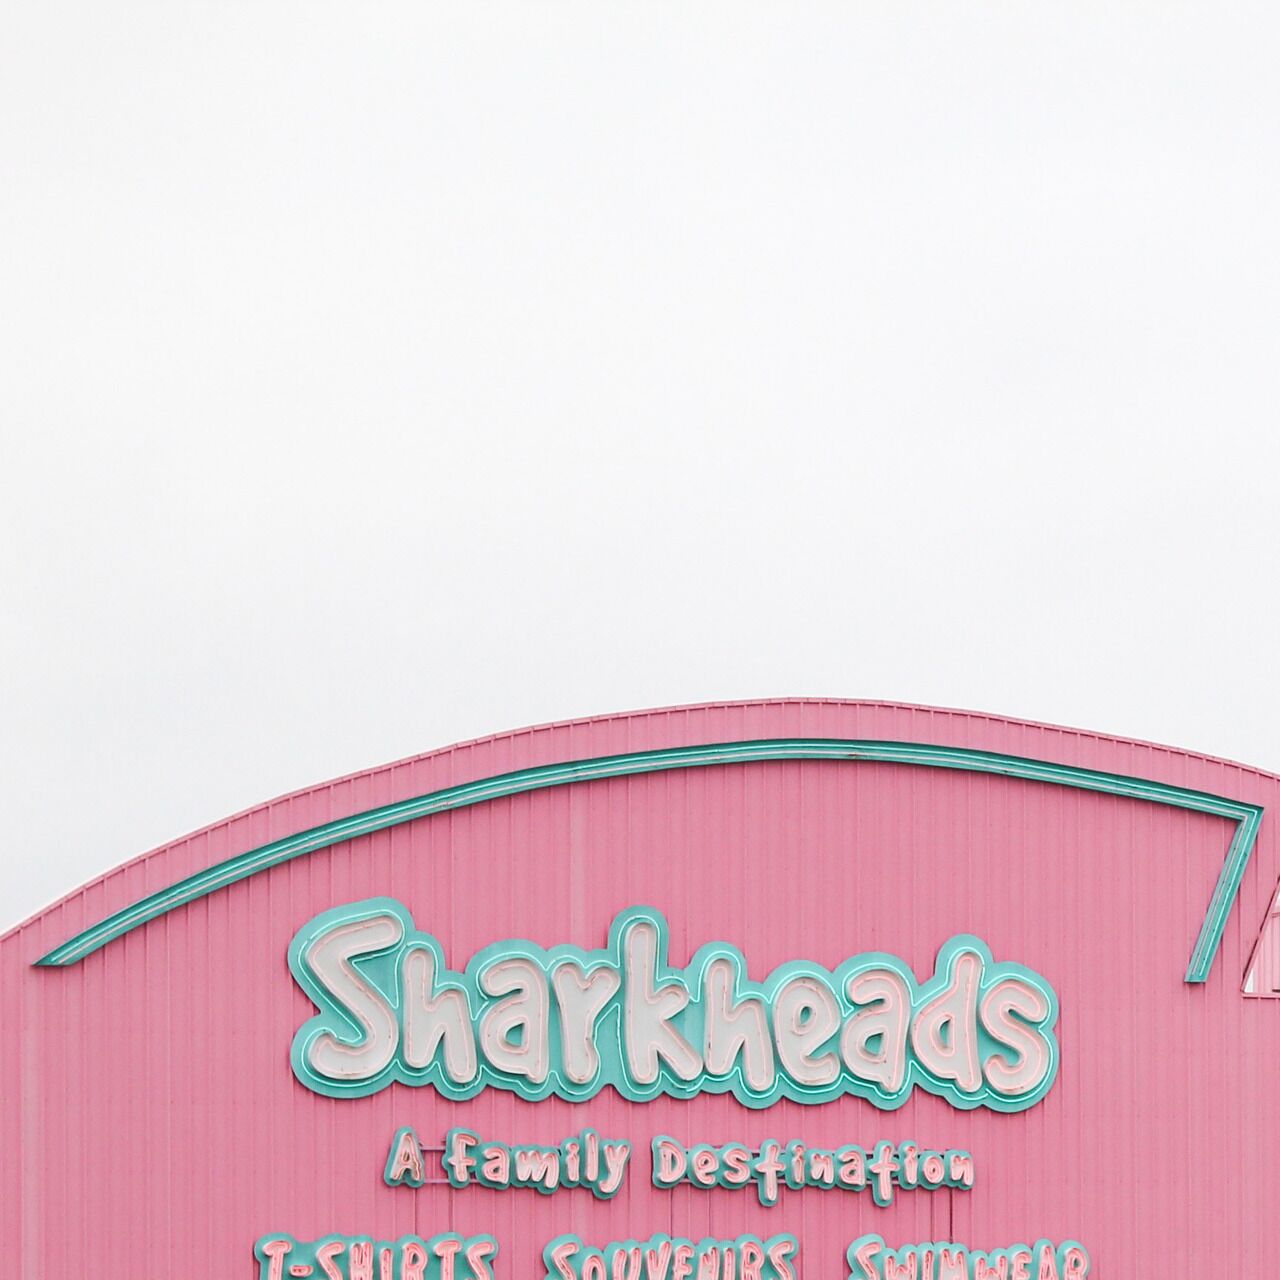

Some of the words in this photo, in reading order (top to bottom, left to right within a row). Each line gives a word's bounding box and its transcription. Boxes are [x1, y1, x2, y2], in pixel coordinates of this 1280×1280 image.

[296, 906, 1054, 1104] Sharkheads
[387, 1130, 423, 1183] A
[653, 1139, 975, 1202] Destination
